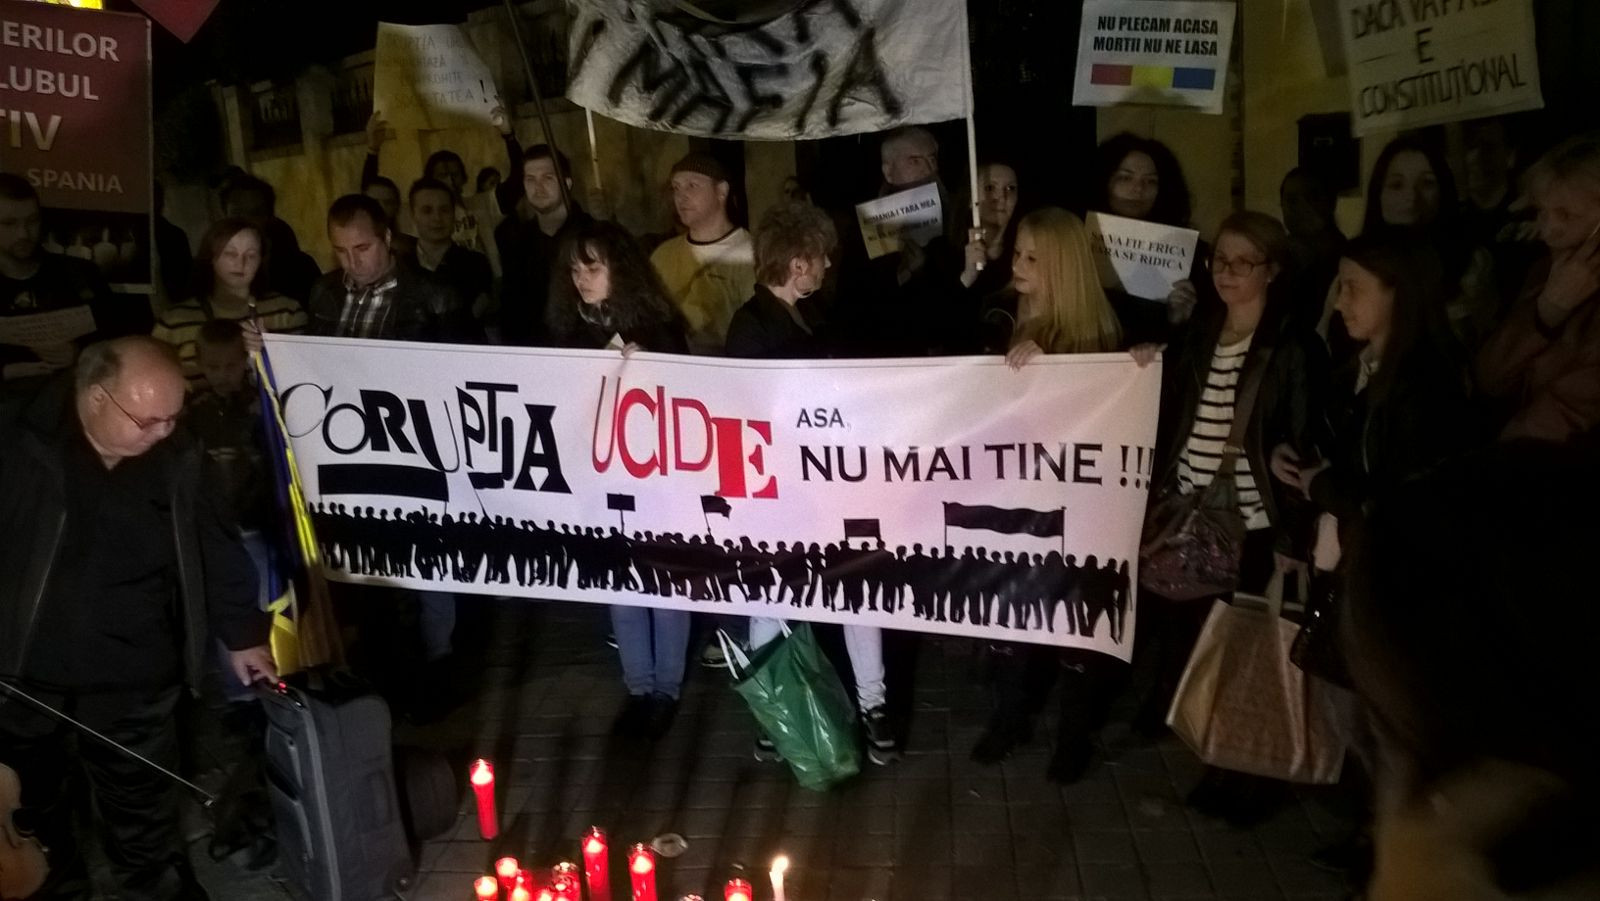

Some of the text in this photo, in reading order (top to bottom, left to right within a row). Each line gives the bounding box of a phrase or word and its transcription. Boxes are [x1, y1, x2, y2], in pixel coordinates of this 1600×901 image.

[1097, 16, 1218, 35] NU PLECAM ACASA
[1093, 36, 1218, 56] MORTII NU NE LASA
[1415, 27, 1434, 64] E
[28, 168, 124, 193] SPANIA
[1125, 237, 1143, 249] FIE
[1148, 241, 1185, 257] FRICA
[1122, 251, 1136, 261] SE
[1139, 254, 1183, 271] RIDICA
[591, 375, 779, 500] UCIDE
[799, 445, 867, 483] NU
[882, 445, 972, 483] MAI
[984, 442, 1103, 486] TINE
